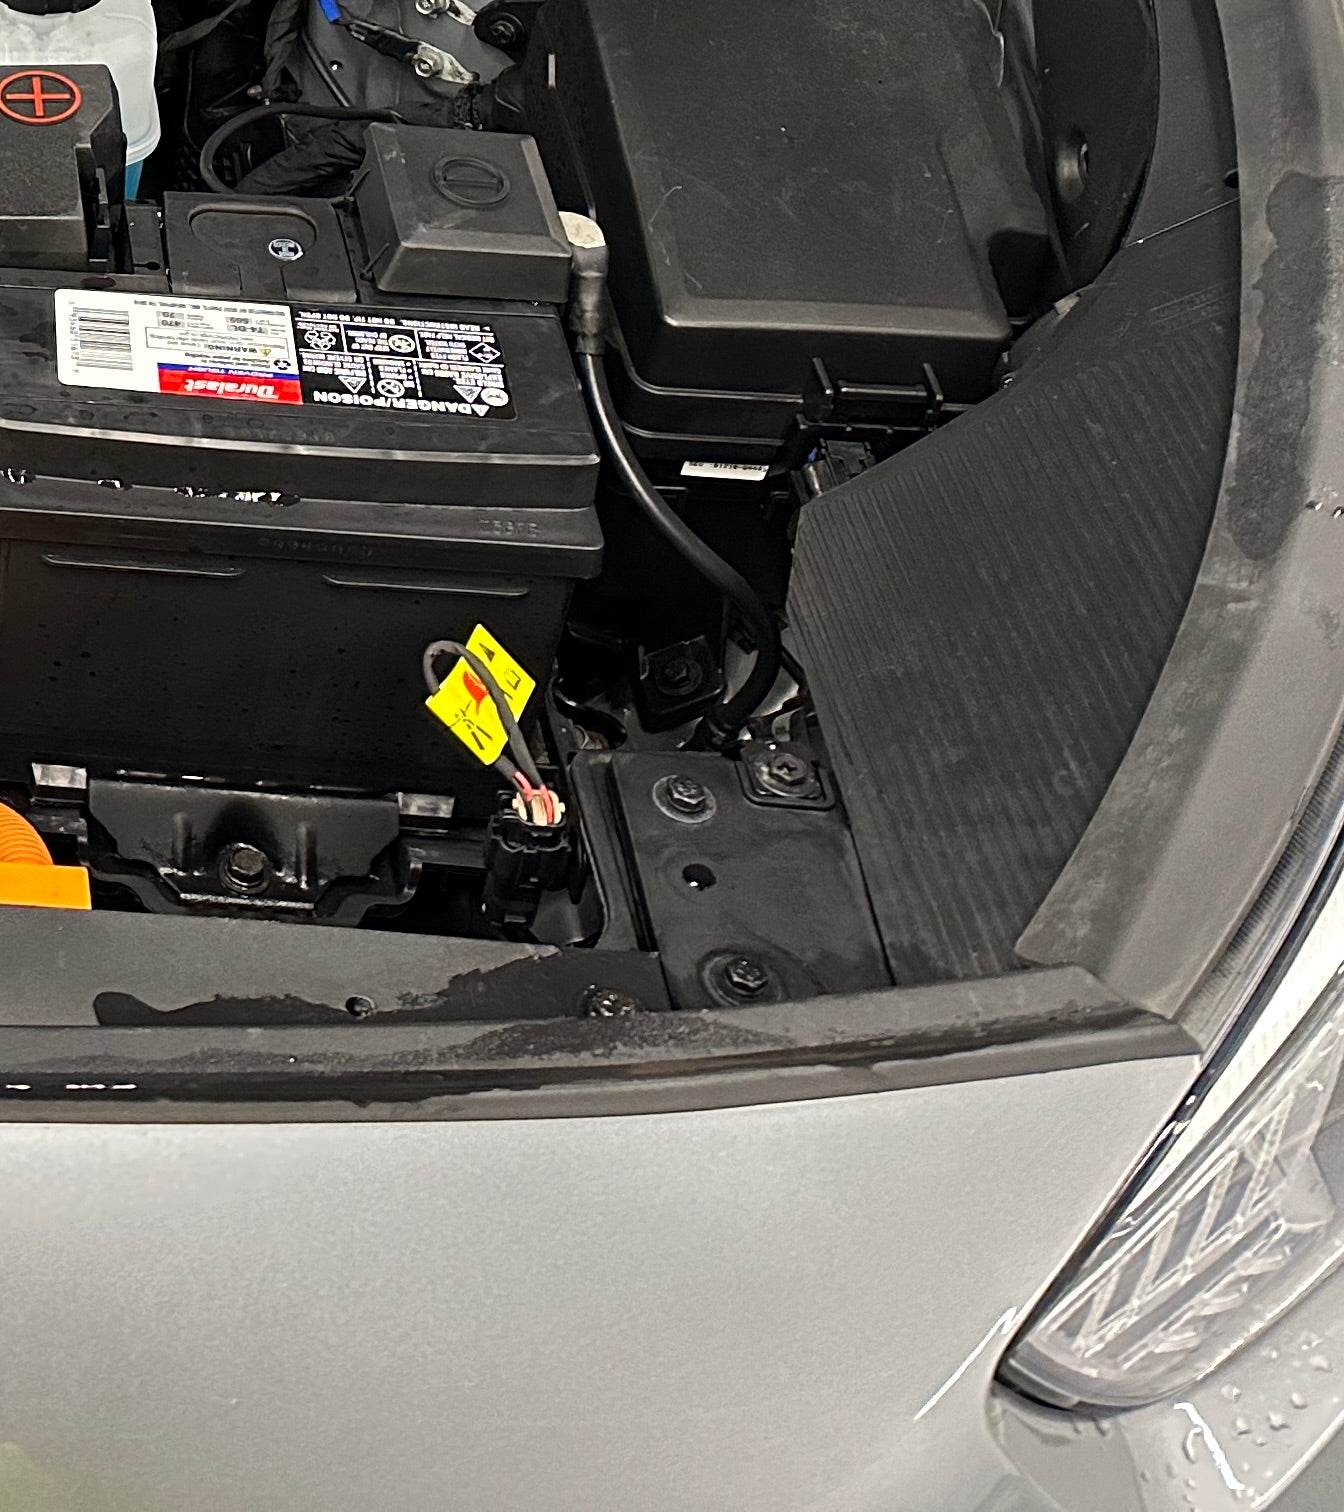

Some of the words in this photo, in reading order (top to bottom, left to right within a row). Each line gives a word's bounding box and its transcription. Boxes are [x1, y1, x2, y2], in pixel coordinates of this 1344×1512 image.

[227, 369, 273, 377] PROVEN
[182, 377, 279, 399] Duralast
[312, 390, 472, 414] DANGER/POISON
